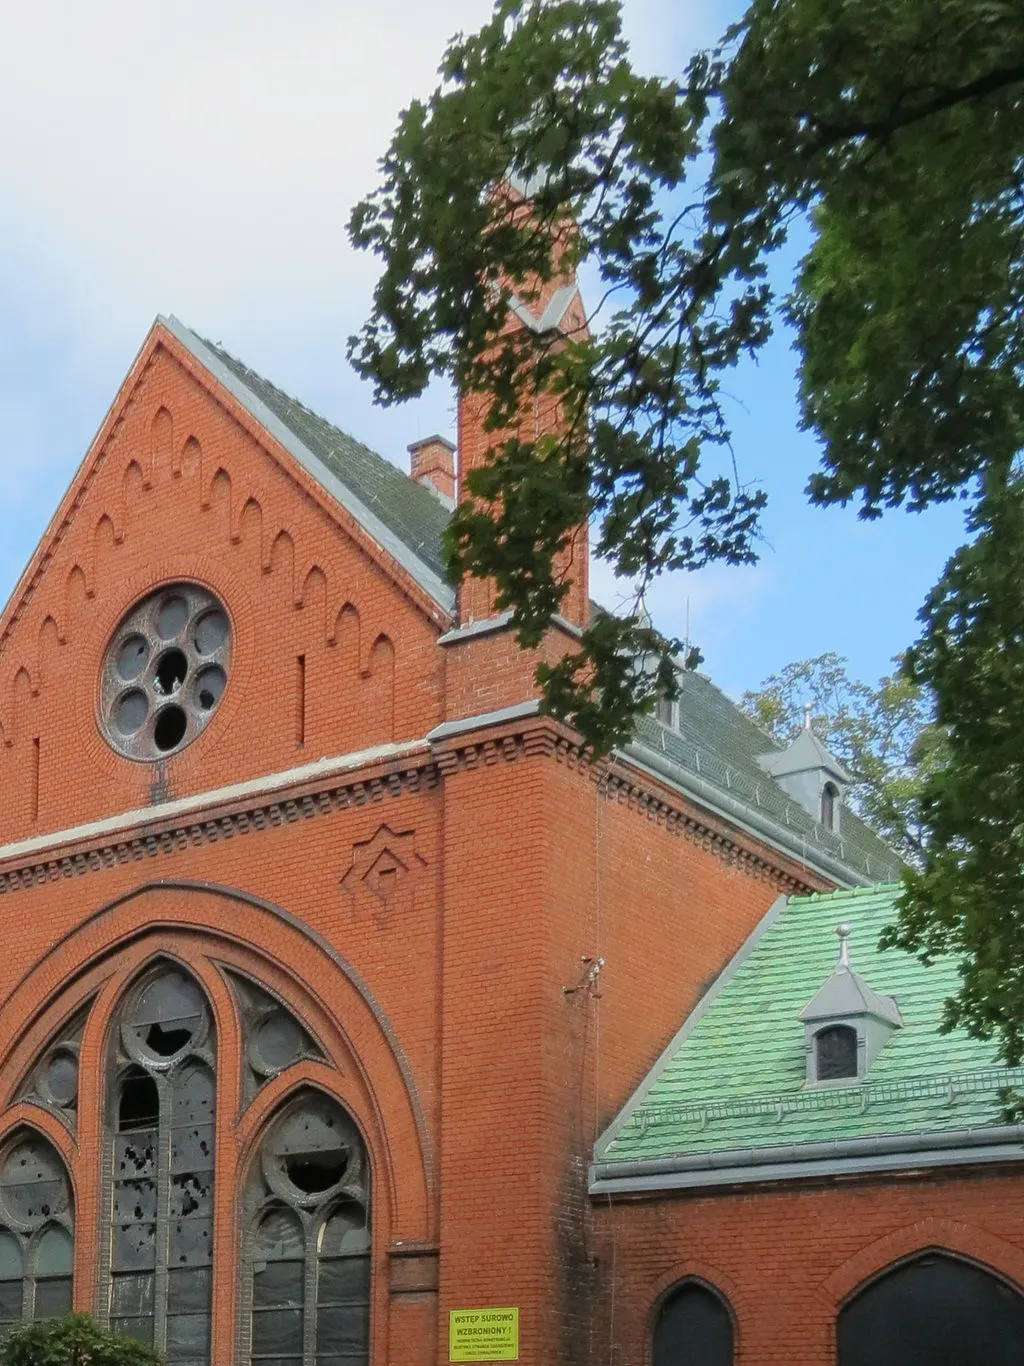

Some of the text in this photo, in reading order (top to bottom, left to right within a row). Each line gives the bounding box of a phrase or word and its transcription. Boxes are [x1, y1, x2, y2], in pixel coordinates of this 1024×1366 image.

[454, 1314, 514, 1324] WSTĘP SUROWO
[456, 1327, 507, 1336] WZBRONIONY
